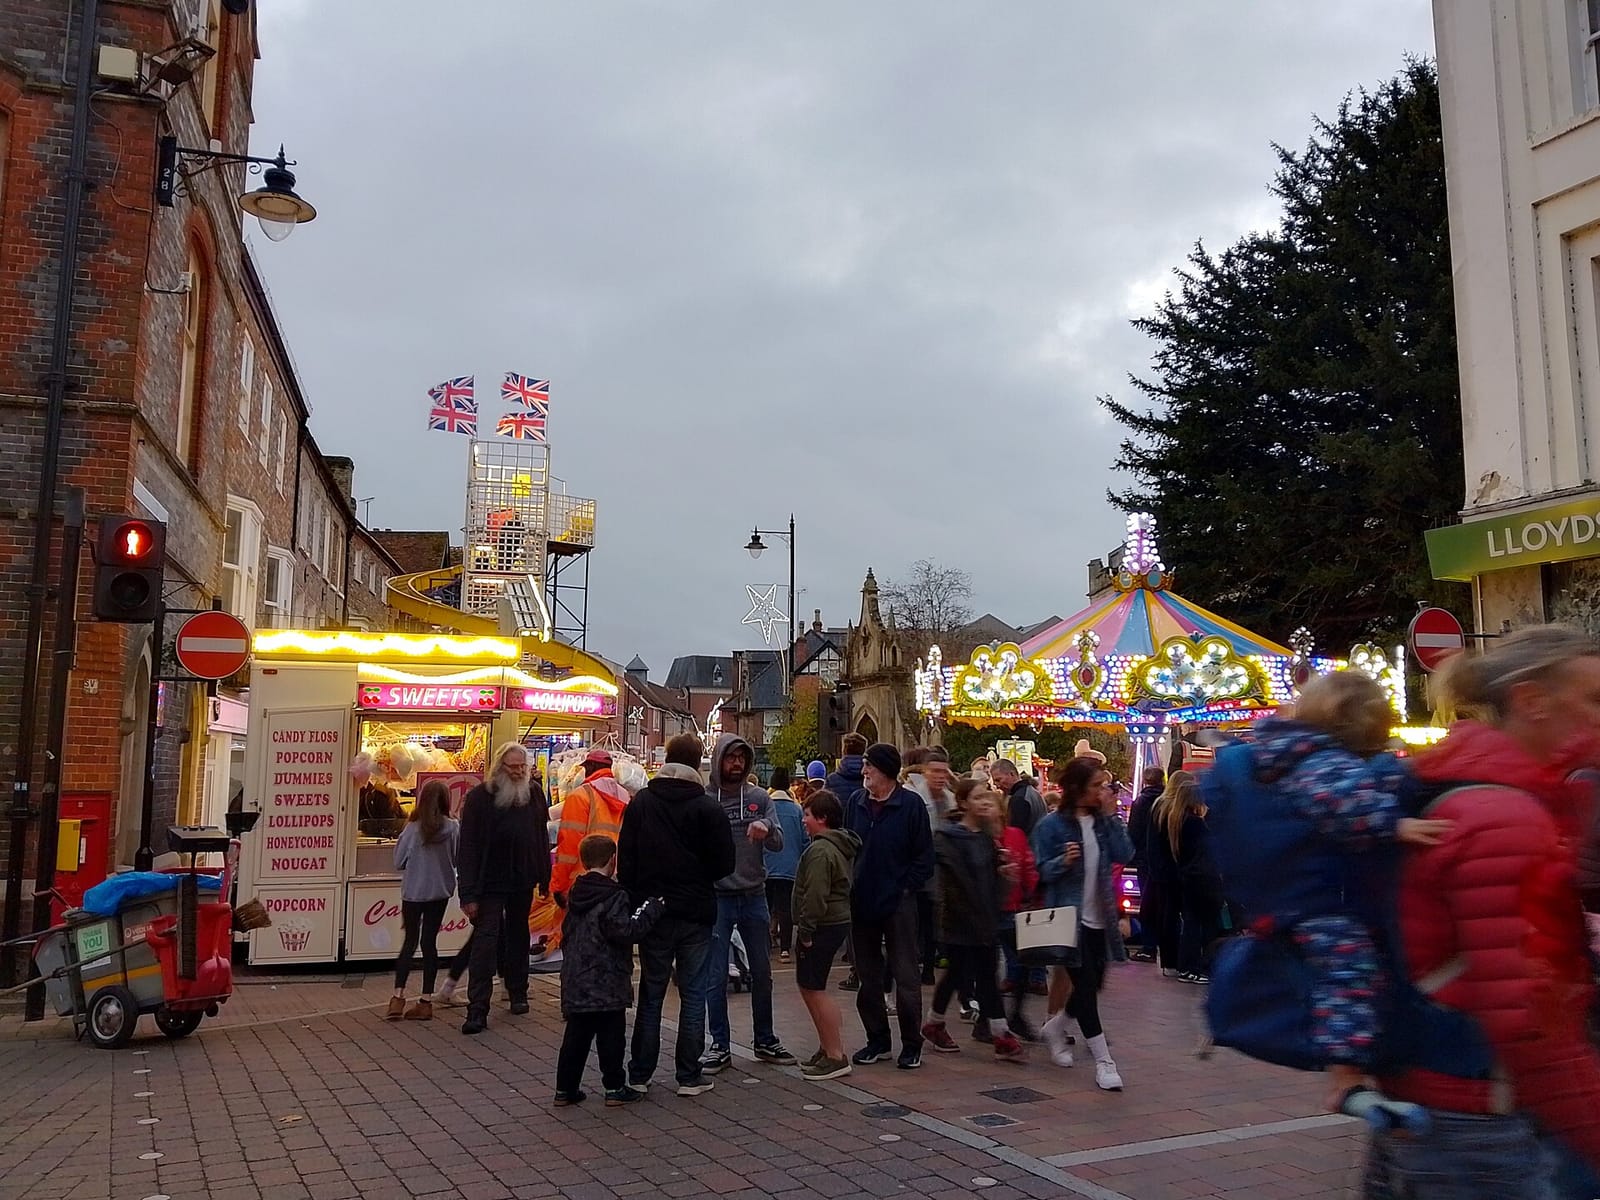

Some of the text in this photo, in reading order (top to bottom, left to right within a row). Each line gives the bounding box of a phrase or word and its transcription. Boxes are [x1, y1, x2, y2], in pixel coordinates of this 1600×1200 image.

[1487, 513, 1600, 558] LLOYD
[387, 687, 473, 706] SWEETS
[532, 692, 597, 713] LOLLIPOPS
[272, 730, 338, 743] CANDY FLOSS
[276, 751, 333, 764] POPCORN
[274, 772, 333, 785] DUMMIES
[274, 793, 330, 807] SWEETS
[269, 814, 334, 828] LOLLIPOPS
[267, 836, 334, 849] HONEYCOMBE
[272, 857, 327, 871] NOUGAT
[266, 898, 326, 912] POPCORN
[83, 936, 103, 950] YOU
